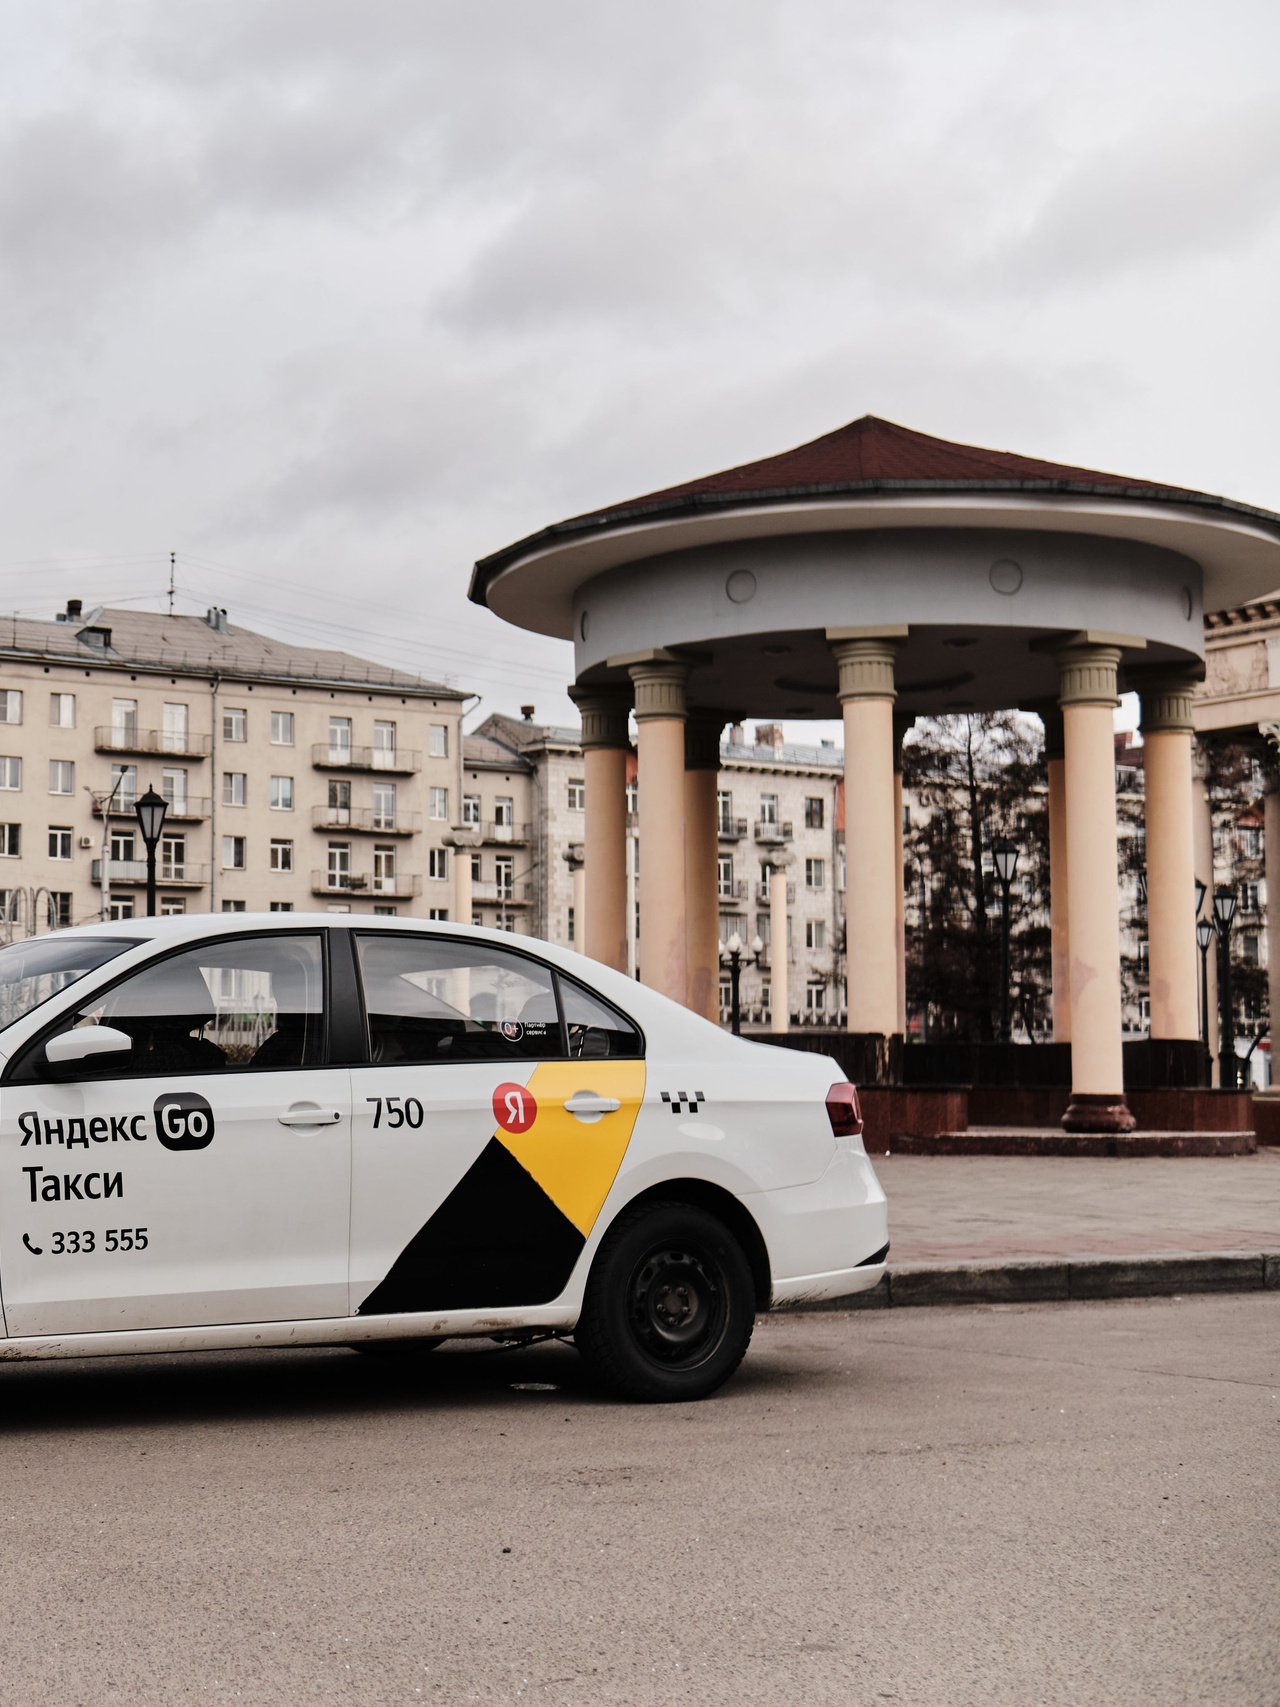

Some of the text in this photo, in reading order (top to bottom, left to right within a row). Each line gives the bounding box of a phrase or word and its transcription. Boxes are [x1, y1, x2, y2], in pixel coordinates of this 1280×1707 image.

[366, 1097, 424, 1129] 750
[504, 1091, 525, 1124] Я
[18, 1103, 208, 1150] Яндекс Go
[22, 1166, 124, 1202] Такси
[50, 1227, 149, 1255] 333 555
